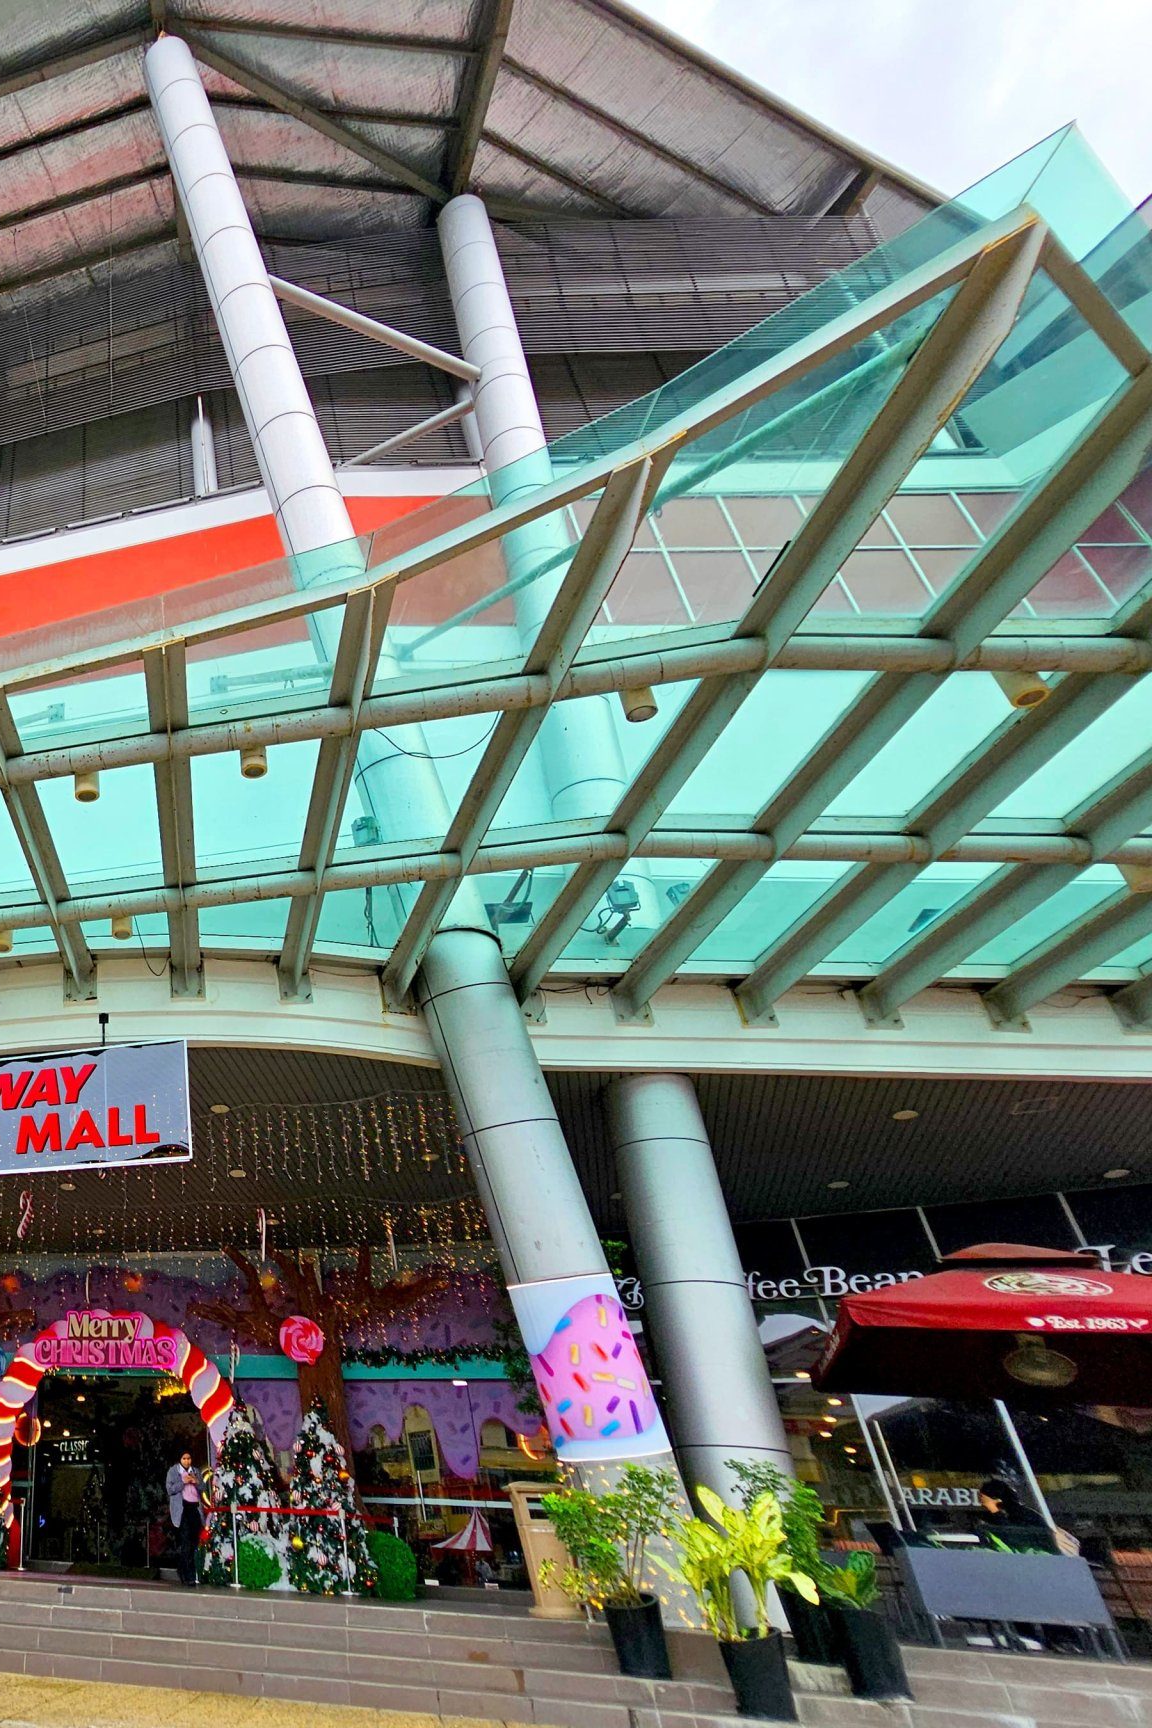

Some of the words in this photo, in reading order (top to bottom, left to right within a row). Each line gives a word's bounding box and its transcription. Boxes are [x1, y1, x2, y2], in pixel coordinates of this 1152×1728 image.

[16, 1104, 160, 1155] MALL
[68, 1312, 140, 1343] Merry
[1045, 1315, 1086, 1330] Est.
[1085, 1316, 1129, 1331] 1963
[35, 1338, 176, 1366] CHRISTMAS
